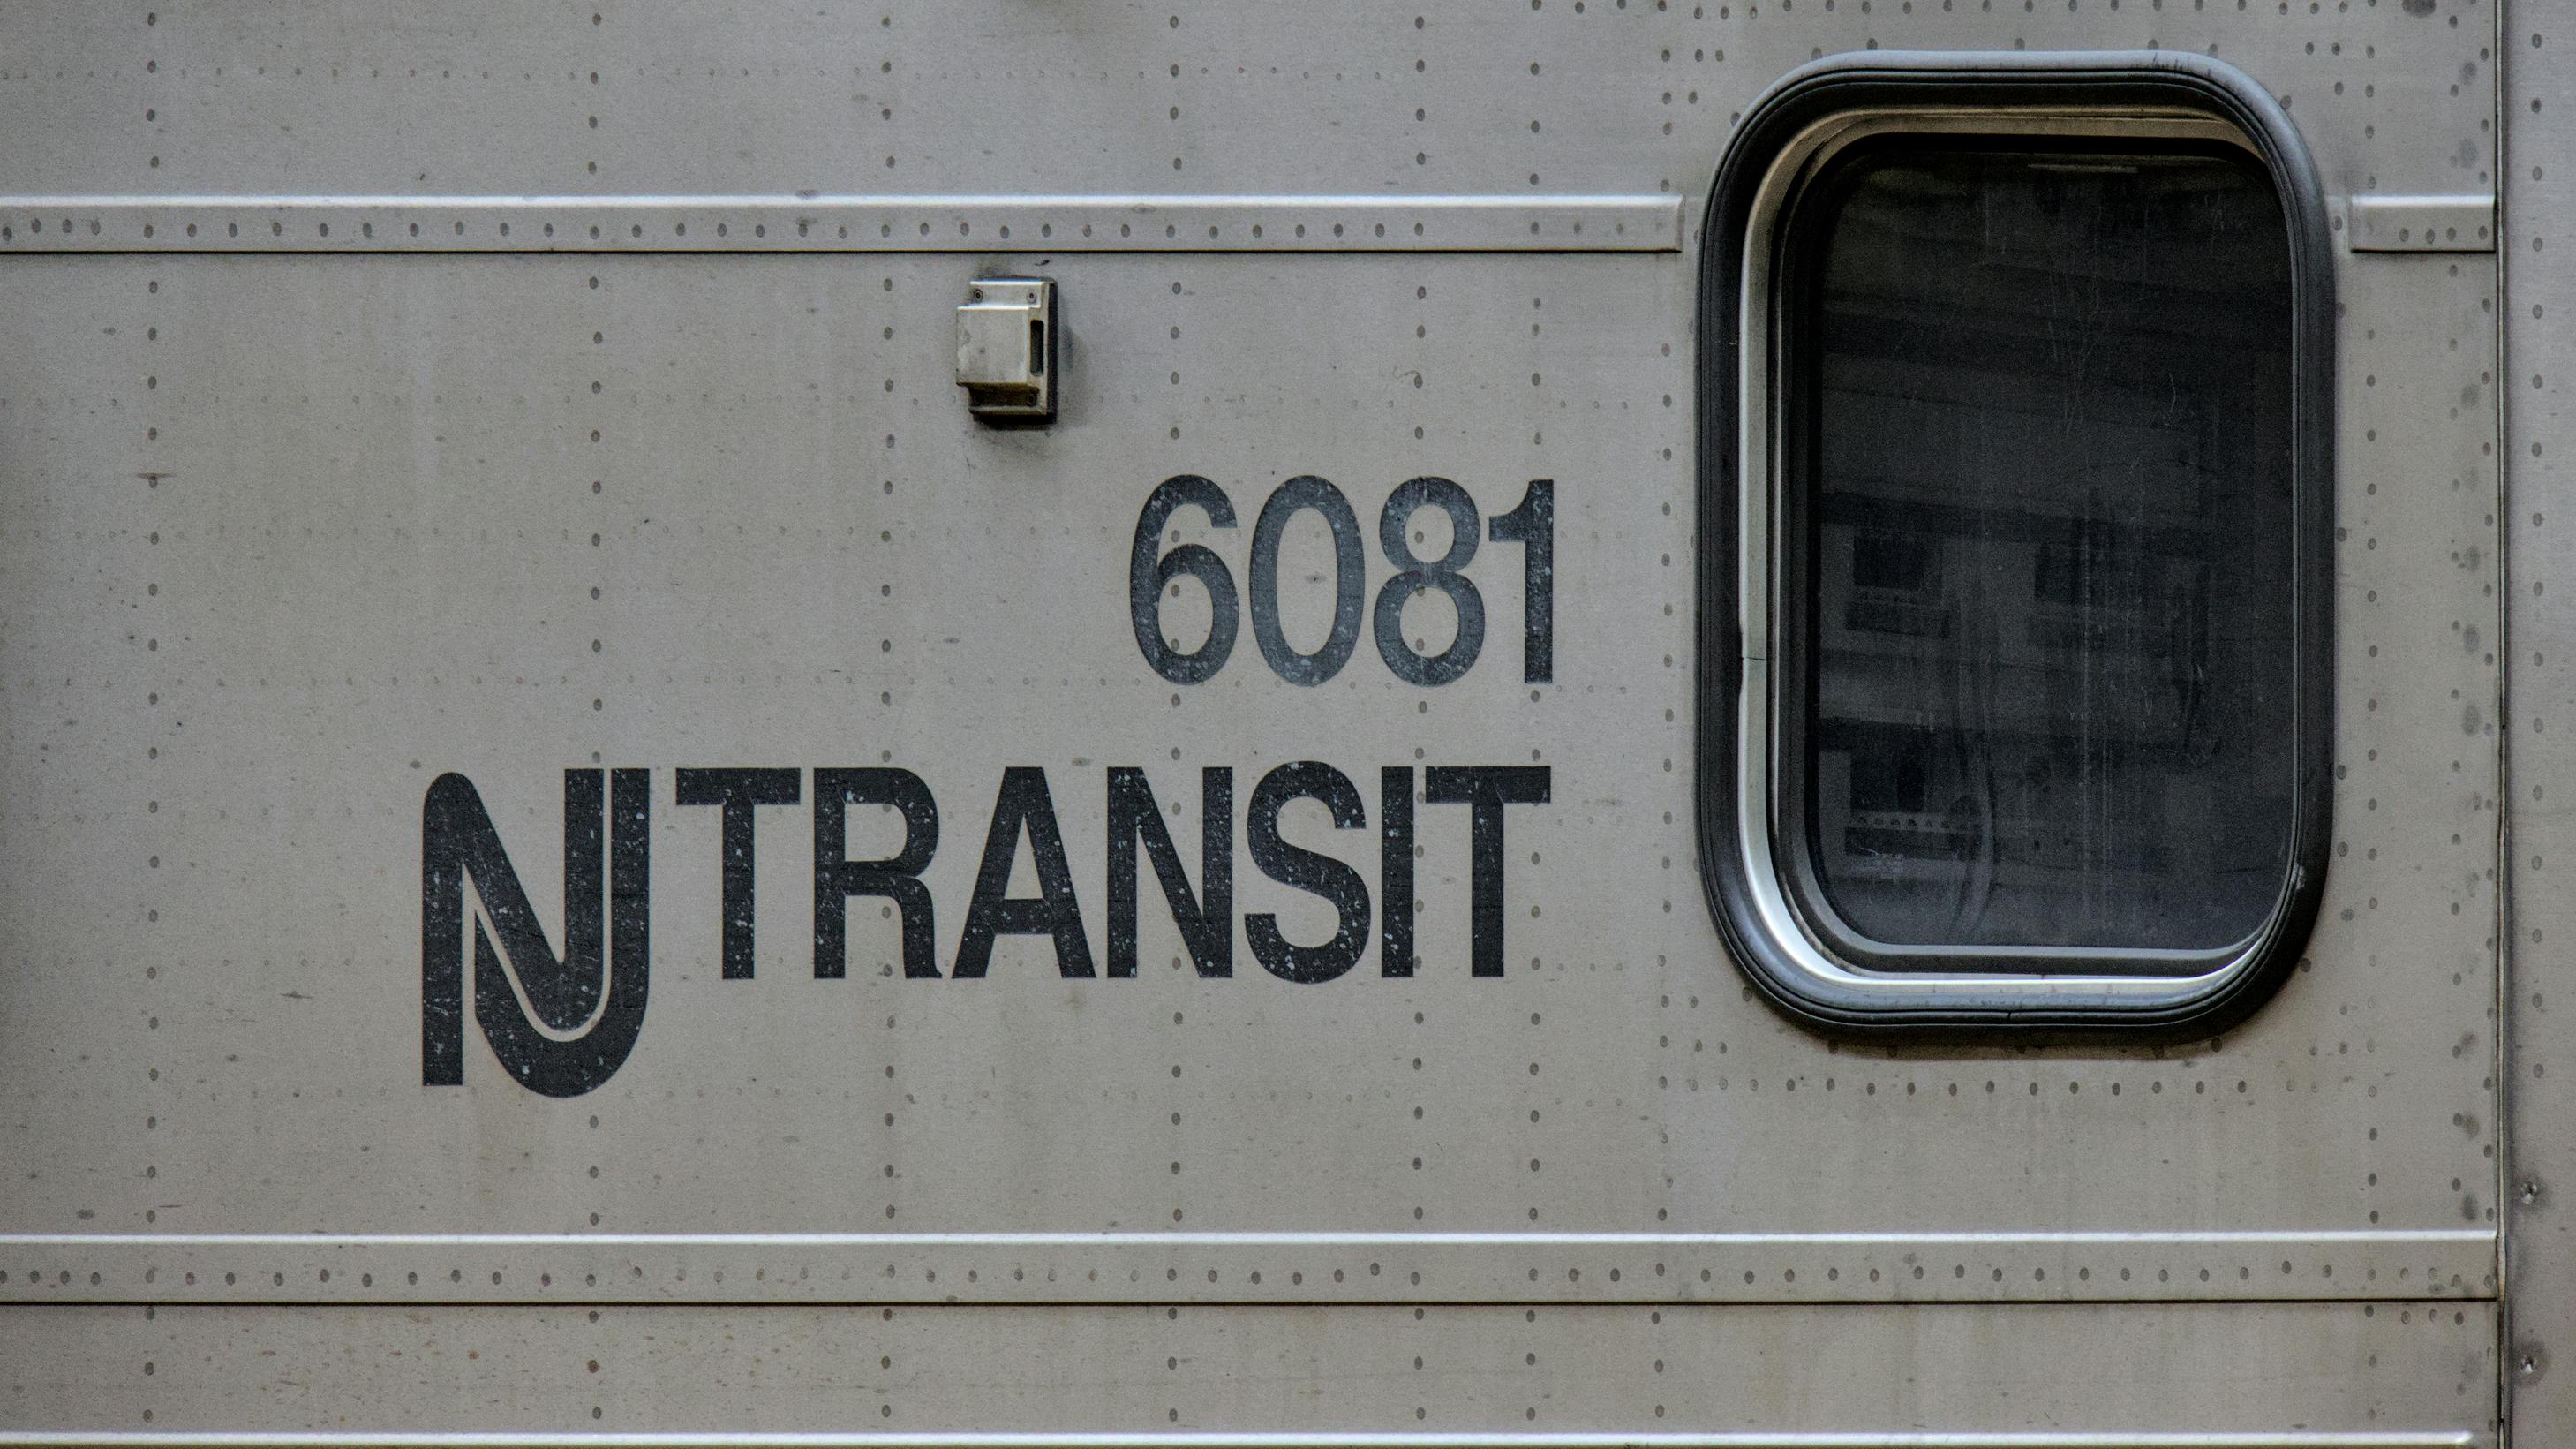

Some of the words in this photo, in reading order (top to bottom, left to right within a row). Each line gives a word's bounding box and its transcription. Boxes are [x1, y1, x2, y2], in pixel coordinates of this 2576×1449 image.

[1130, 474, 1555, 686] 6081
[422, 767, 651, 1099] NJ
[675, 760, 1552, 985] TRANSIT
